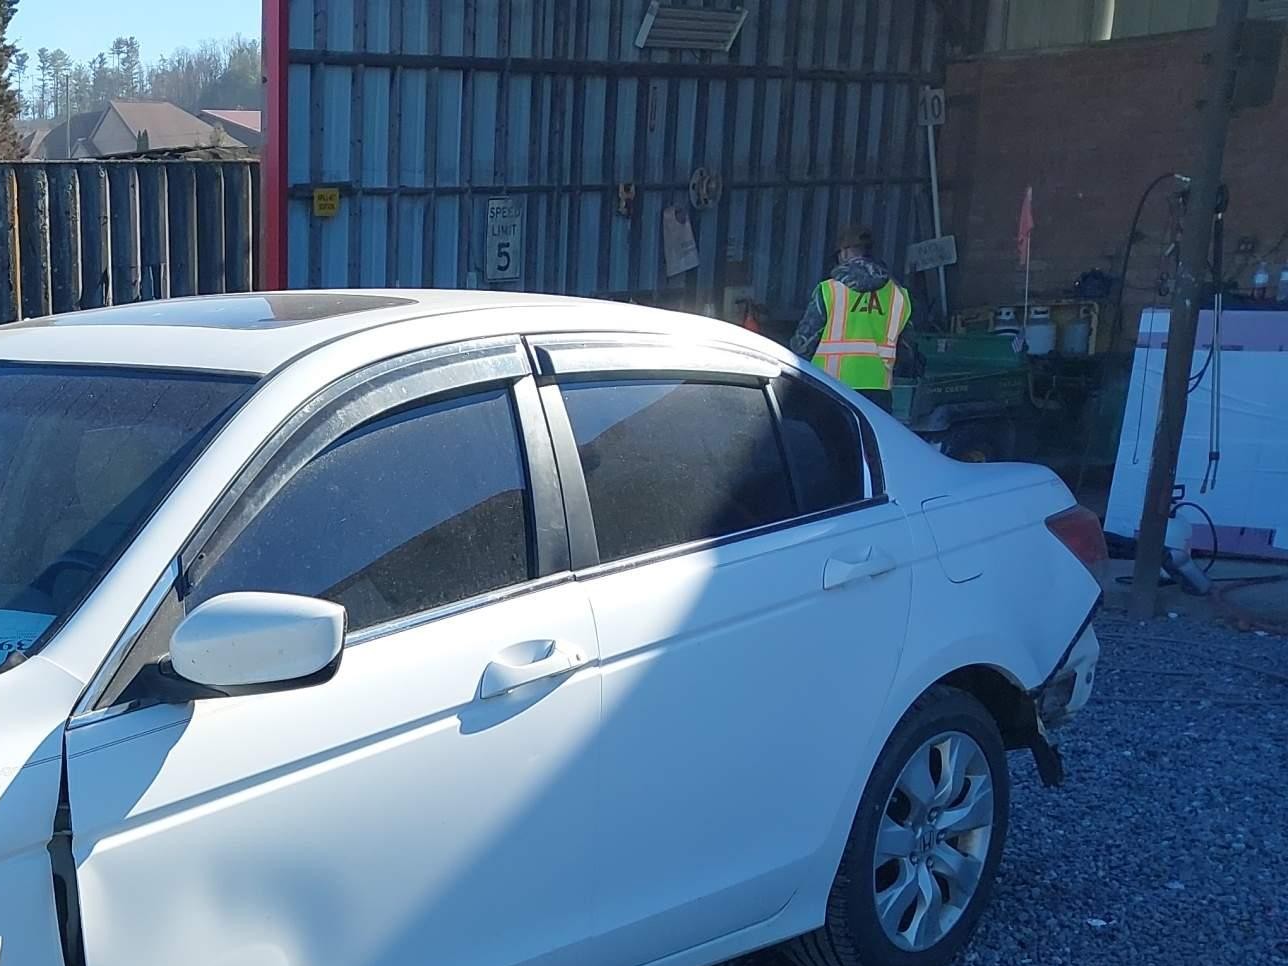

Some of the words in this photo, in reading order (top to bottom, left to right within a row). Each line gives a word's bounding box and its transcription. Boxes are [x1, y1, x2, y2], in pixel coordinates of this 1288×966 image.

[919, 94, 942, 120] 10
[489, 206, 521, 218] SPEED
[491, 223, 517, 236] LIMIT
[496, 242, 511, 272] 5
